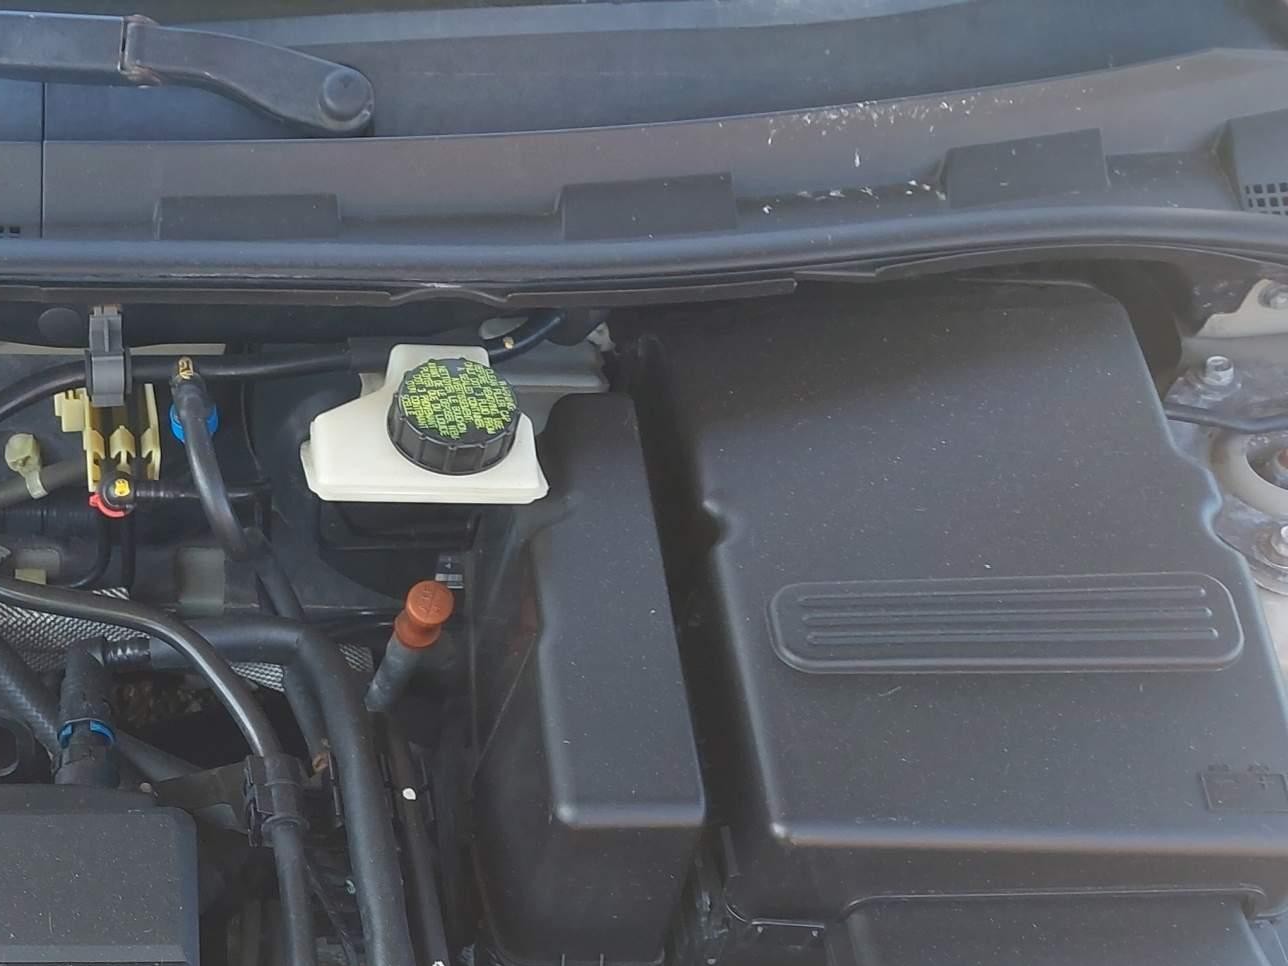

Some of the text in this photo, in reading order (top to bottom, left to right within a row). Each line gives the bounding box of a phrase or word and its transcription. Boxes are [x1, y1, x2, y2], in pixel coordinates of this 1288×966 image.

[464, 362, 477, 375] ONLY
[459, 374, 474, 394] SEALED
[470, 378, 481, 388] DOT
[413, 374, 424, 384] DOT
[419, 395, 438, 428] PROVENANT
[419, 367, 434, 387] PLOYER
[427, 390, 439, 401] QUE
[435, 415, 450, 436] LIQUIDE
[438, 366, 455, 393] NETTOYER
[451, 406, 468, 433] BOUCHON
[485, 369, 512, 422] CLEAN FILLER CAP
[410, 396, 429, 428] CONTENANT
[477, 399, 490, 415] FLUID
[483, 418, 497, 434] FROM
[493, 418, 505, 430] USE
